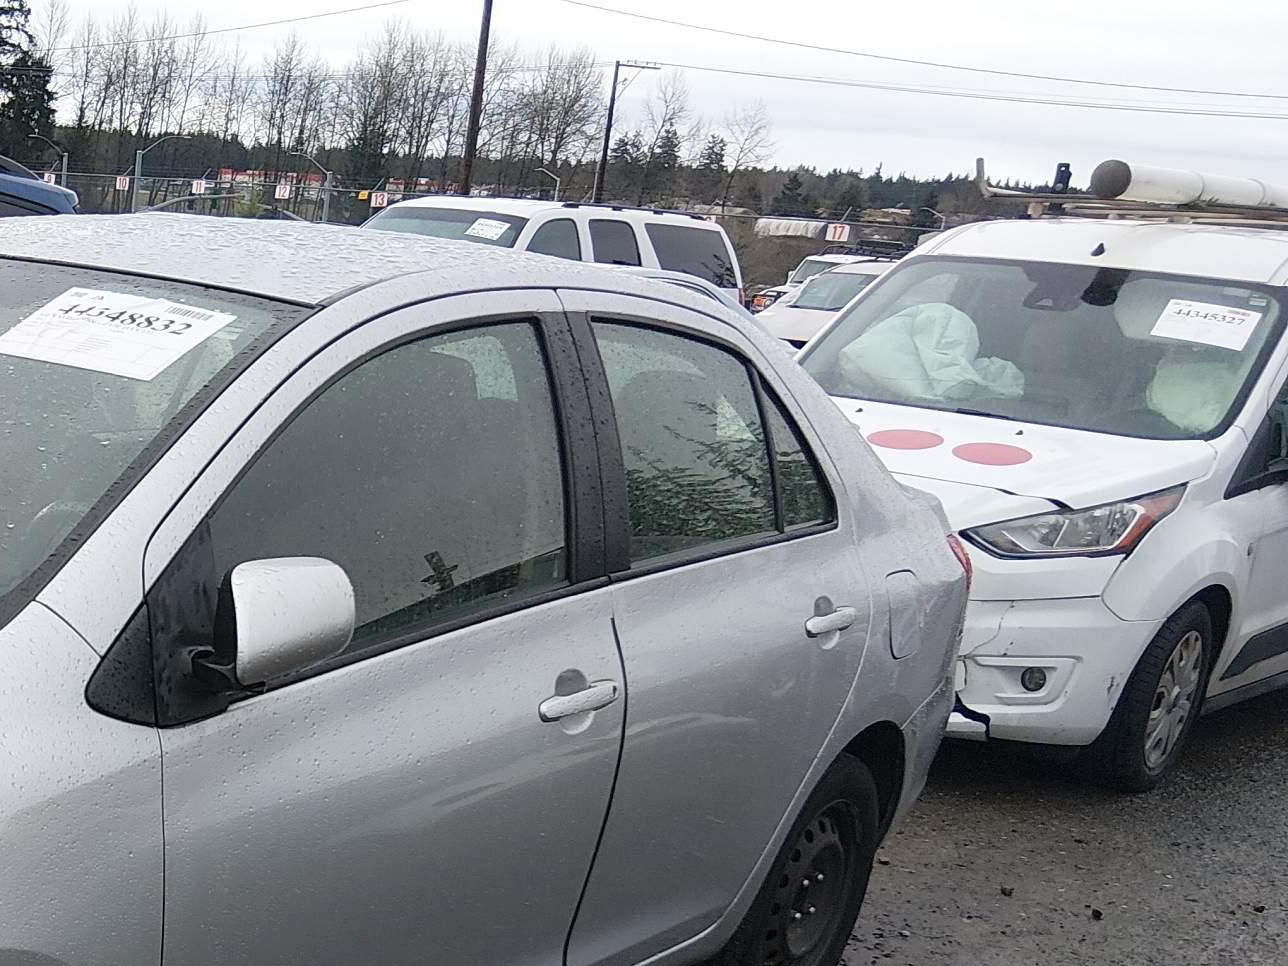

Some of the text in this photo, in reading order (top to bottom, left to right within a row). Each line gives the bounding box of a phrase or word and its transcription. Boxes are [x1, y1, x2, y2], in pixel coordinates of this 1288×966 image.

[118, 177, 127, 189] 10
[195, 181, 202, 193] 11
[278, 186, 288, 198] 12
[374, 193, 386, 206] 13
[832, 225, 846, 240] 17
[1173, 308, 1246, 326] 44345327
